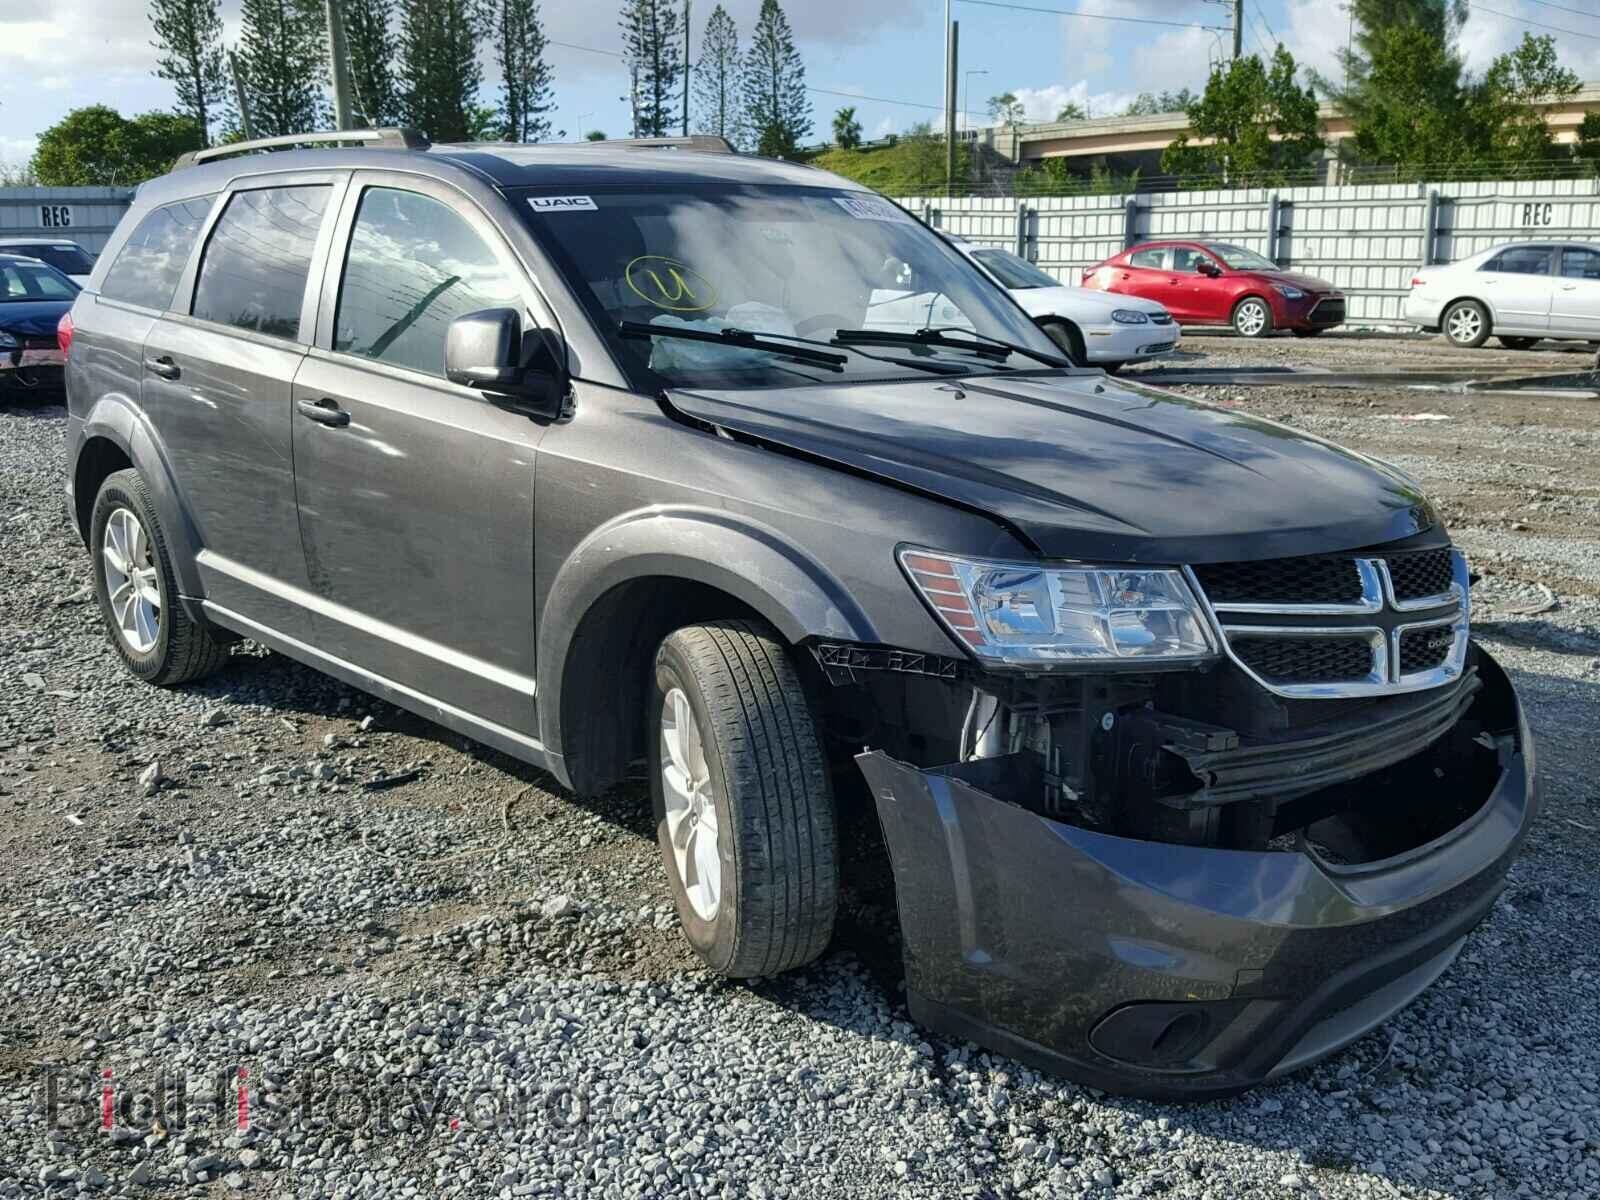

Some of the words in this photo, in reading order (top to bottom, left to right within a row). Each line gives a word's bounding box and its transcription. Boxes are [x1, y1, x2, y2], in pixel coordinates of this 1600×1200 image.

[533, 198, 590, 206] UAIC
[41, 206, 70, 227] REC
[1522, 203, 1552, 226] REC
